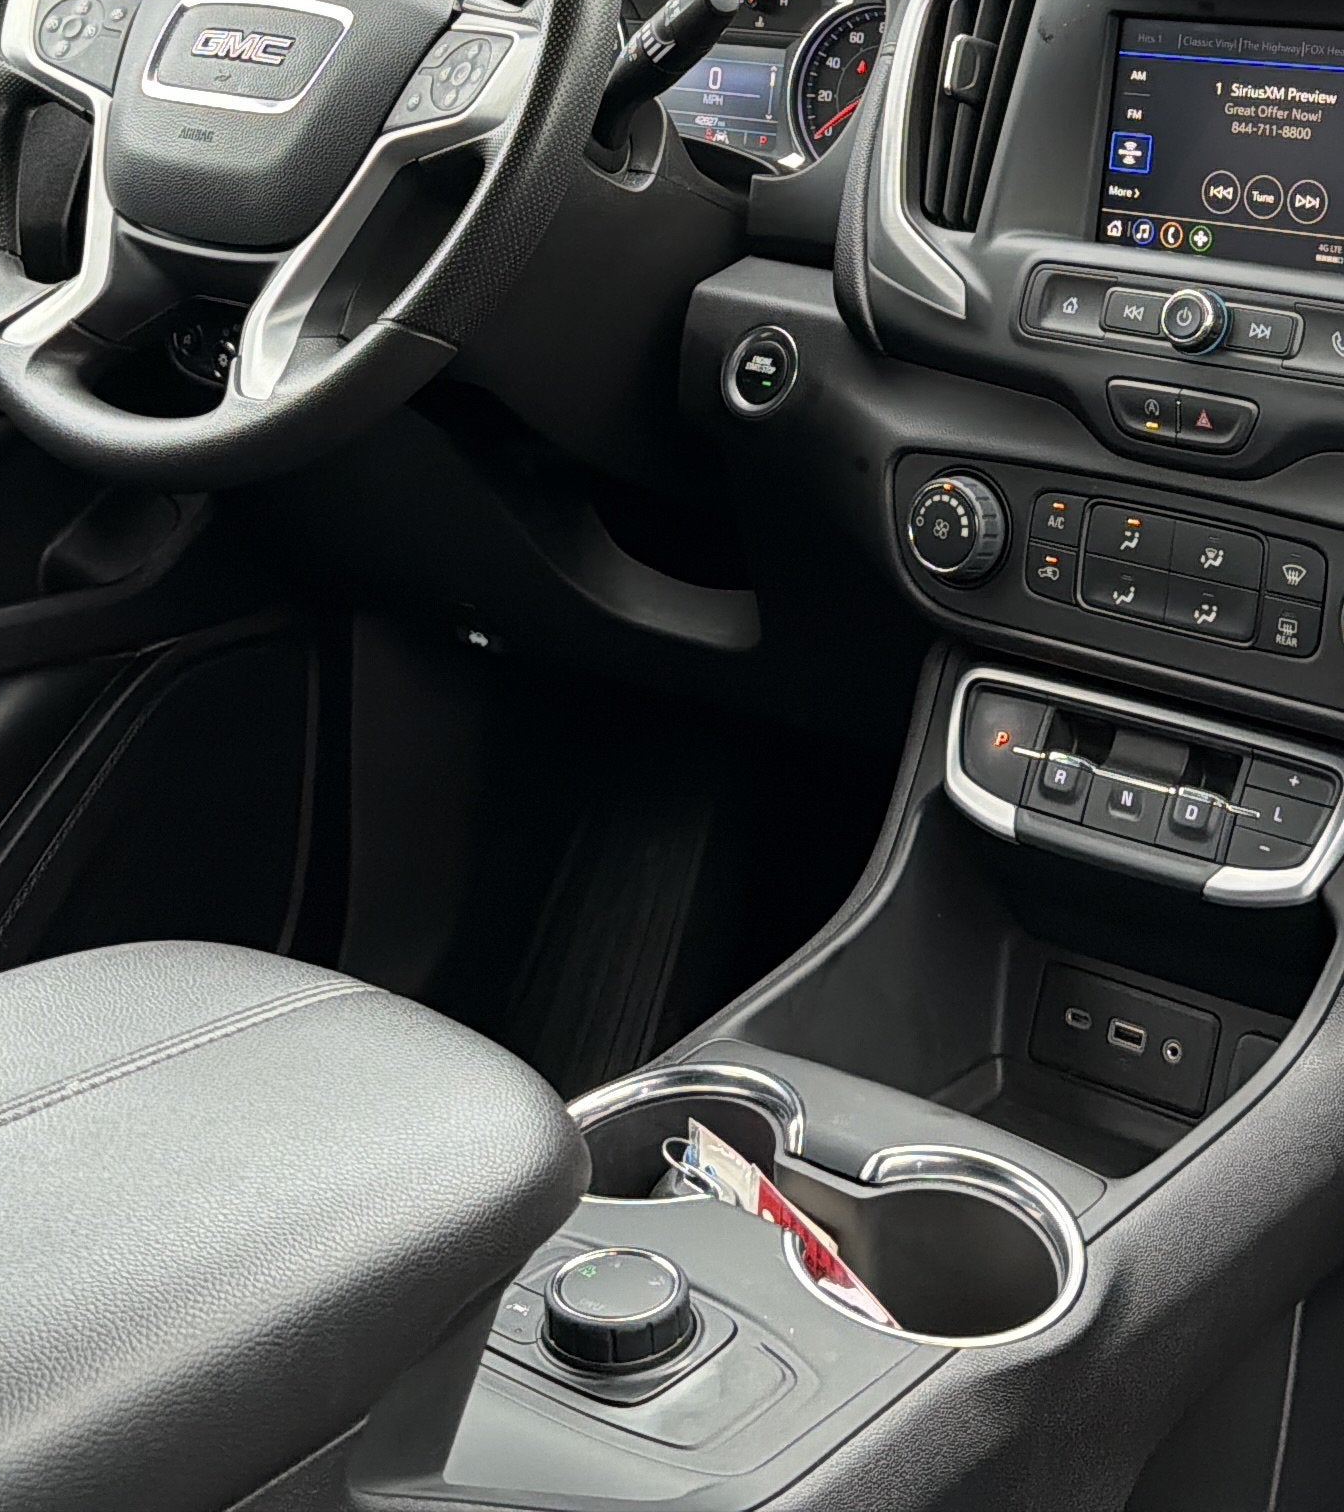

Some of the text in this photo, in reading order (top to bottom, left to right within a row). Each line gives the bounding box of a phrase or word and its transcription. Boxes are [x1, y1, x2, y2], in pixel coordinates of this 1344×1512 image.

[849, 31, 865, 44] 60
[1137, 33, 1156, 44] Hits
[1182, 36, 1238, 51] Classic Vinyl
[191, 27, 296, 67] GMC
[1243, 39, 1302, 56] The Highway
[1305, 44, 1325, 56] FOX
[825, 56, 841, 69] 40
[708, 66, 722, 90] 0
[1130, 70, 1147, 81] AM
[702, 93, 724, 106] MPH
[817, 89, 833, 102] 20
[1215, 82, 1338, 105] 1 SiriusXM Preview
[1126, 108, 1143, 120] FM
[1224, 103, 1323, 123] Great Offer Now!
[178, 128, 215, 143] AIRBAG
[1231, 121, 1312, 140] 844-711-8800
[1108, 184, 1133, 198] More
[1251, 190, 1275, 204] Tune
[1317, 243, 1343, 254] 4G LTE
[1047, 514, 1065, 530] A/C
[1275, 633, 1298, 648] REAR
[994, 730, 1010, 748] P
[1120, 789, 1134, 808] N
[1185, 804, 1199, 821] D
[1272, 806, 1284, 823] L
